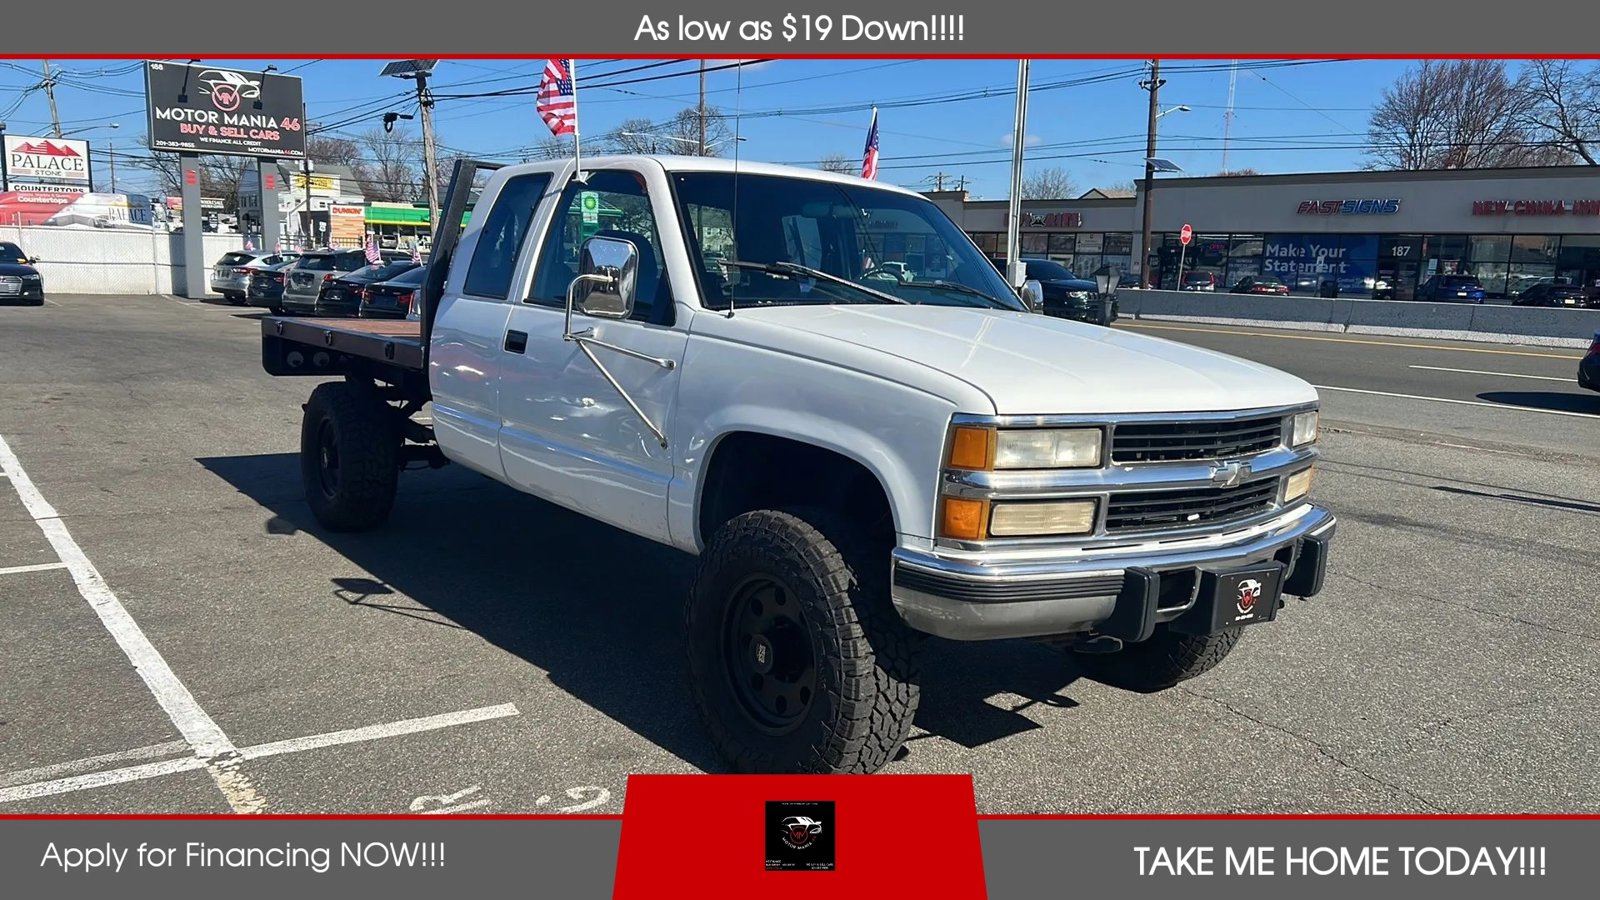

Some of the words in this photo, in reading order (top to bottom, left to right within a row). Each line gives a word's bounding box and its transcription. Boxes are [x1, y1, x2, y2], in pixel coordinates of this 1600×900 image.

[156, 107, 218, 124] MOTOR
[224, 113, 278, 129] MANIA
[280, 117, 301, 131] 46
[180, 123, 207, 134] BUY
[208, 125, 218, 136] &
[220, 127, 248, 138] SELL
[250, 130, 280, 141] CARS
[11, 153, 84, 171] PALACE
[17, 196, 68, 205] Countertops
[1296, 199, 1401, 216] FASTSIGNS
[1472, 200, 1509, 216] NEW
[1514, 200, 1565, 216] CHINA
[108, 207, 146, 221] PALACE
[1265, 244, 1305, 258] Make
[1310, 245, 1347, 258] Your
[1392, 246, 1411, 257] 187
[1264, 259, 1347, 274] Statement
